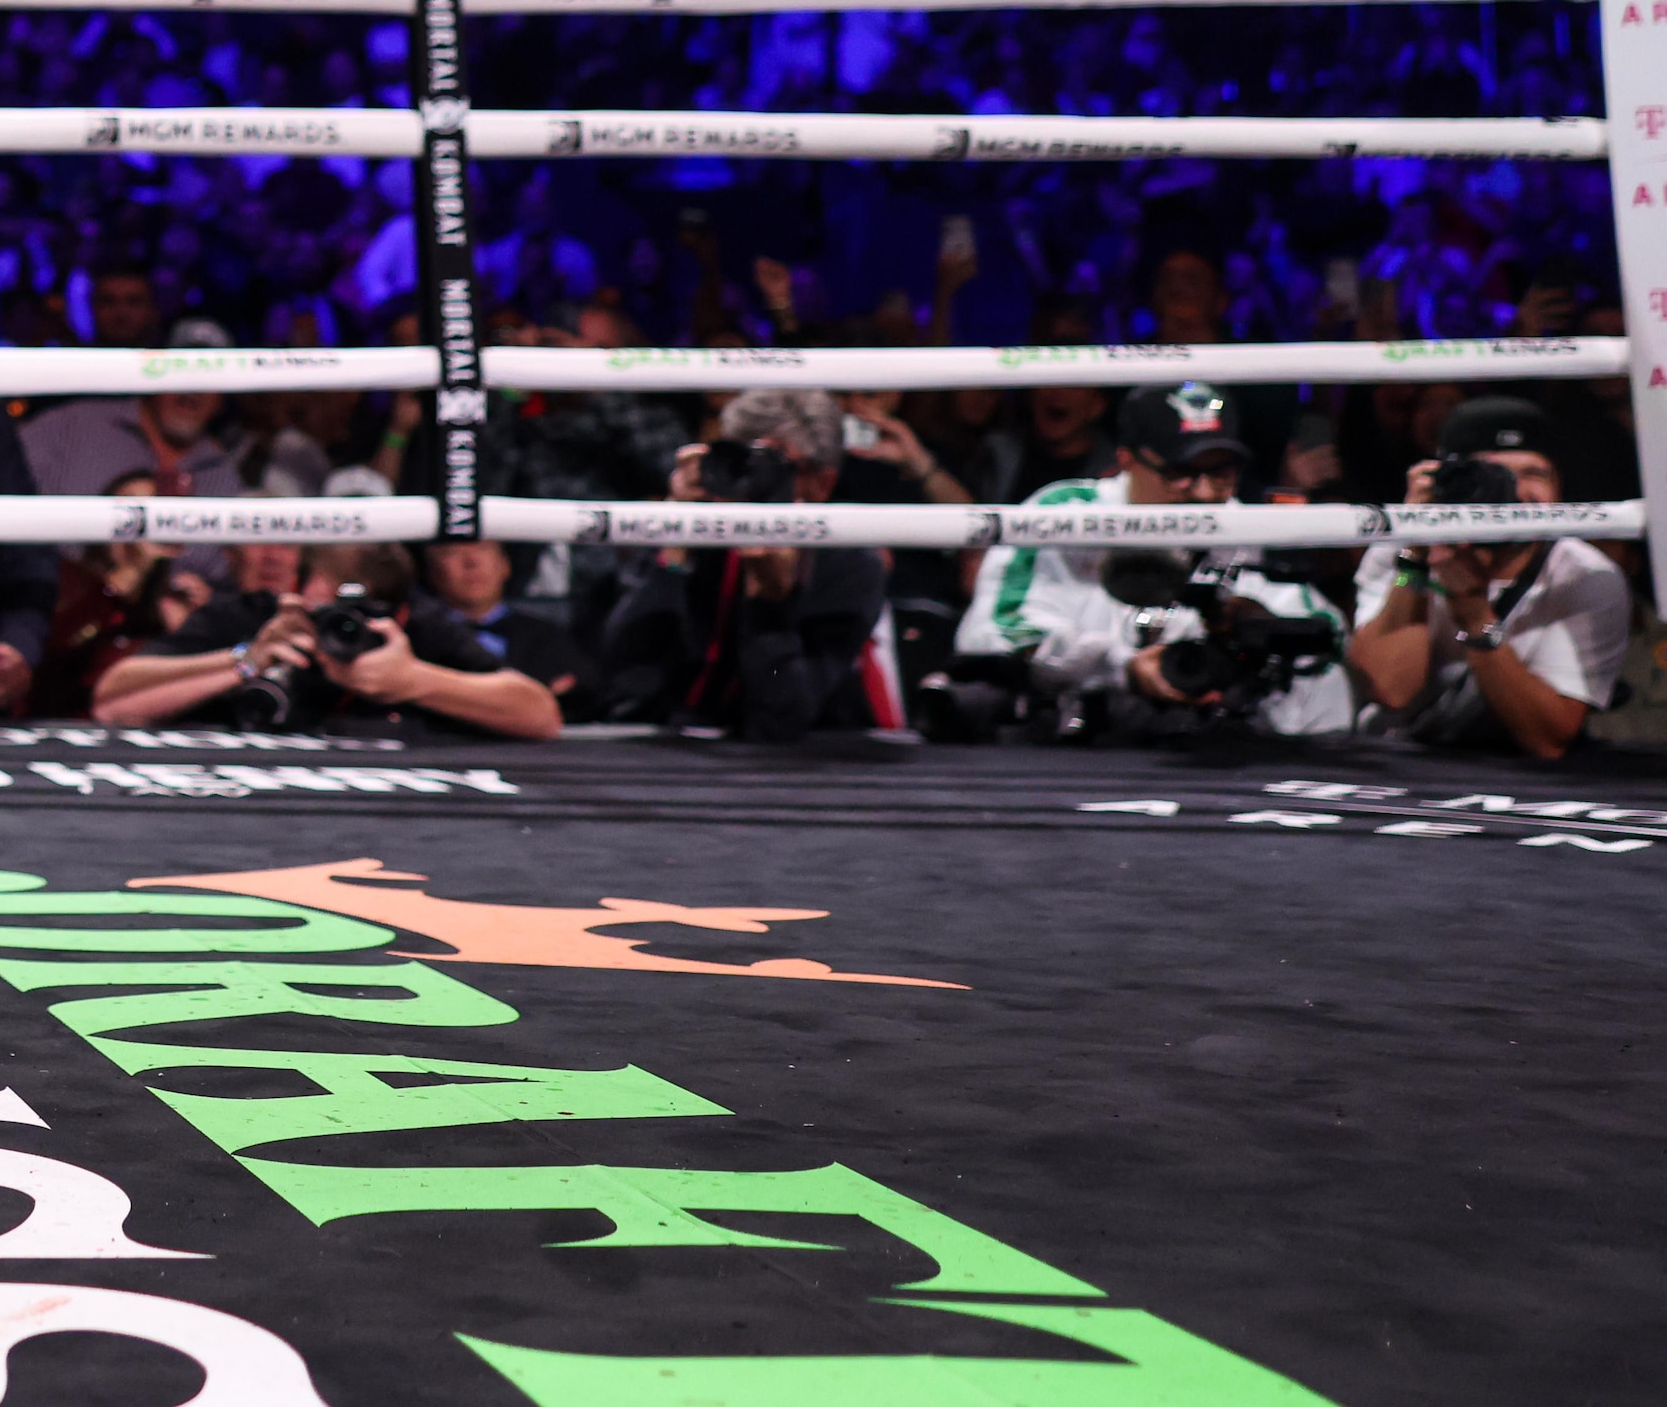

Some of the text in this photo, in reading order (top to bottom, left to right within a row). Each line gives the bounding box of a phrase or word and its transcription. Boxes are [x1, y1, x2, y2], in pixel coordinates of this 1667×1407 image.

[128, 122, 341, 144] MGM REWARDS
[156, 515, 366, 536] MGM REWARDS
[620, 518, 831, 539] MGM REWARDS
[1011, 516, 1218, 538] MGM REWARDS
